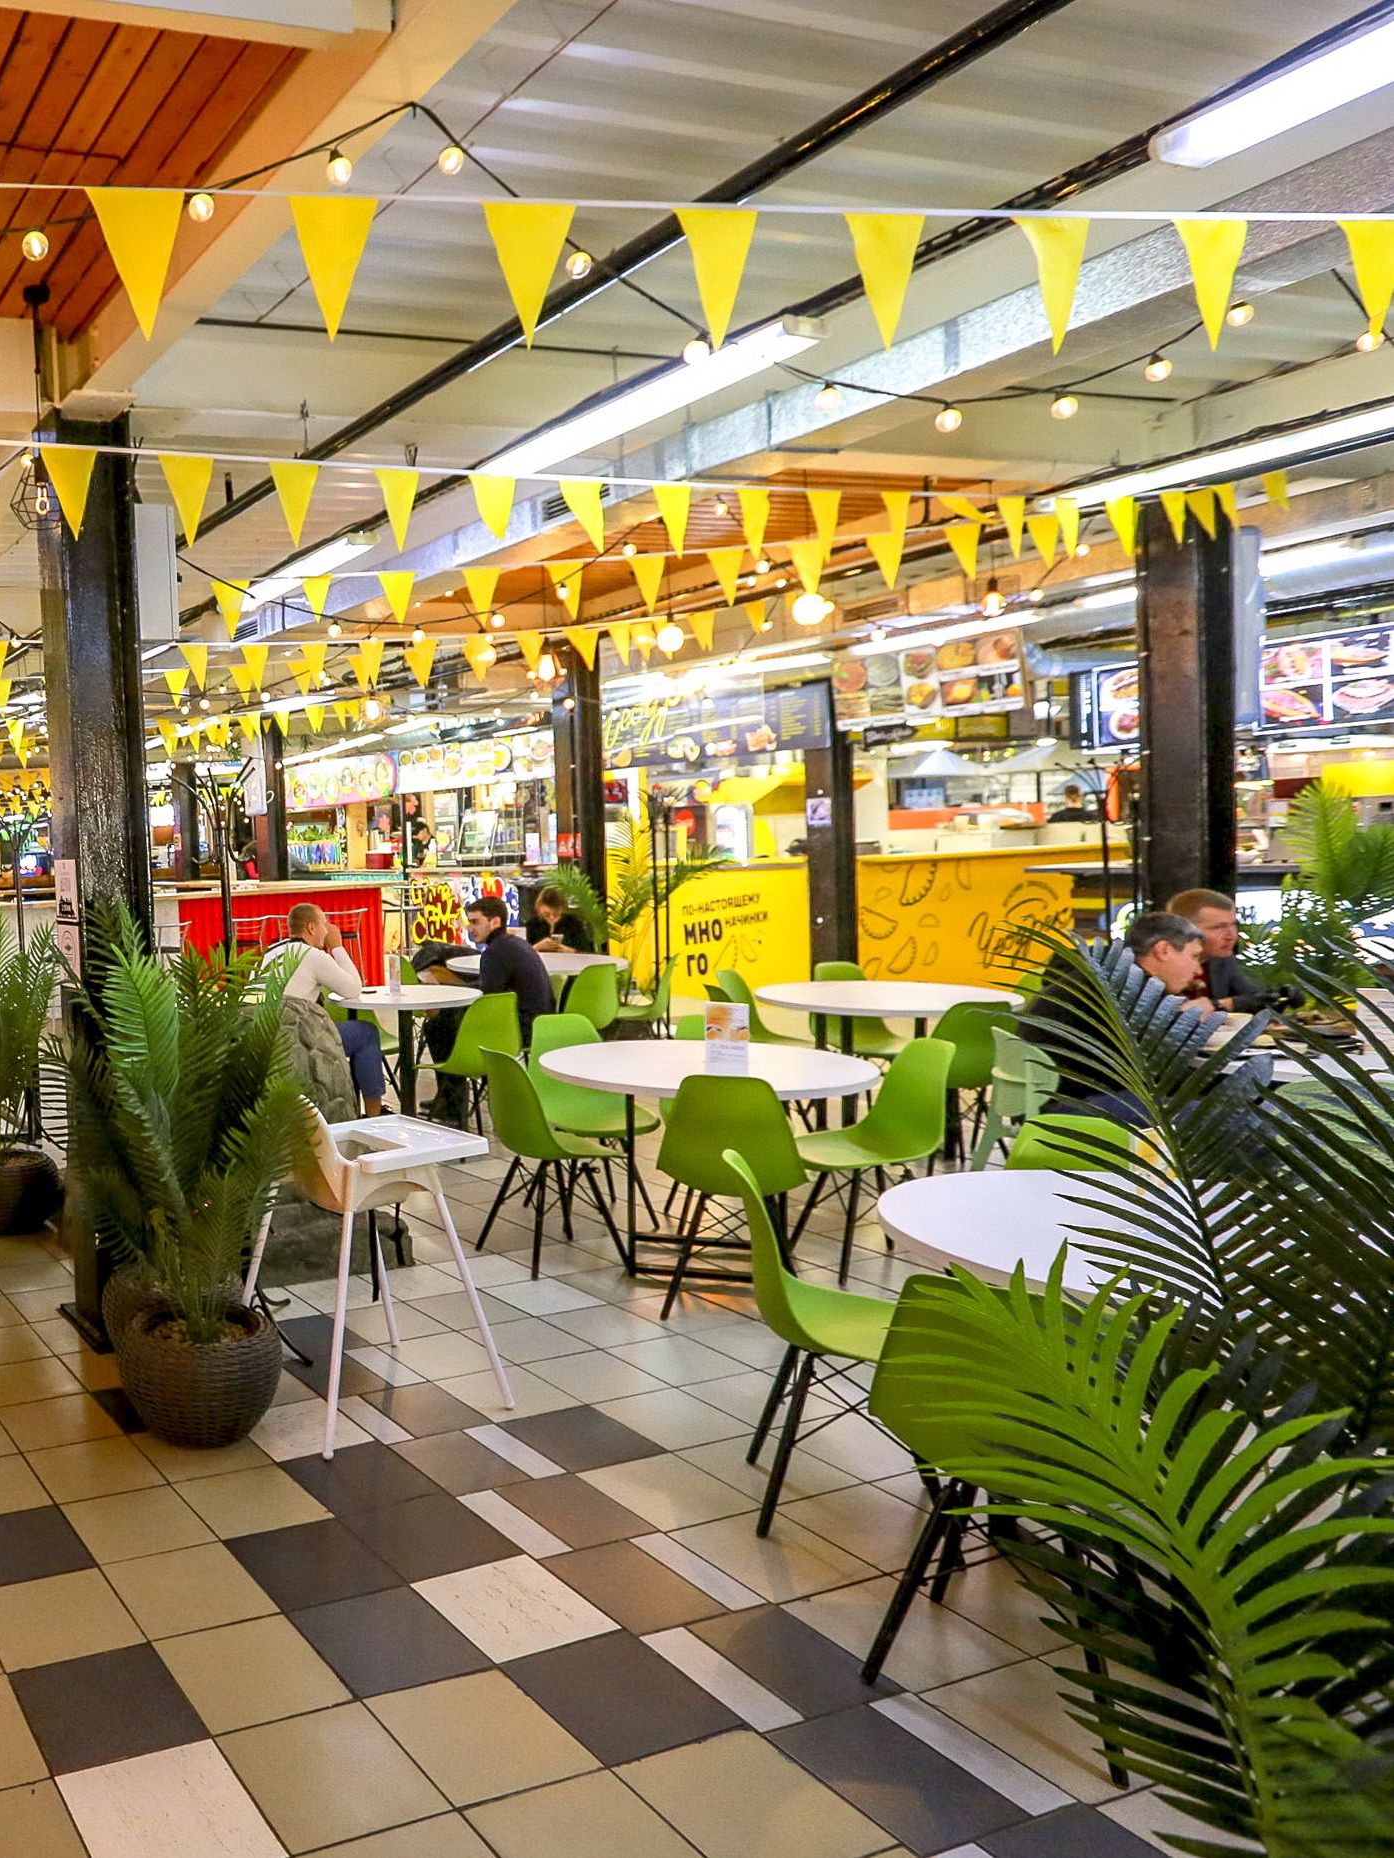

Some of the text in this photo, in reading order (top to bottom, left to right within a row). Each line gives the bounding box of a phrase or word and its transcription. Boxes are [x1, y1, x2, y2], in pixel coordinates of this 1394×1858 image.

[682, 893, 761, 916] ПО-НАСТОЯЩЕМУ
[684, 911, 769, 946] МНО НАЧИНКИ
[686, 953, 708, 977] ГО
